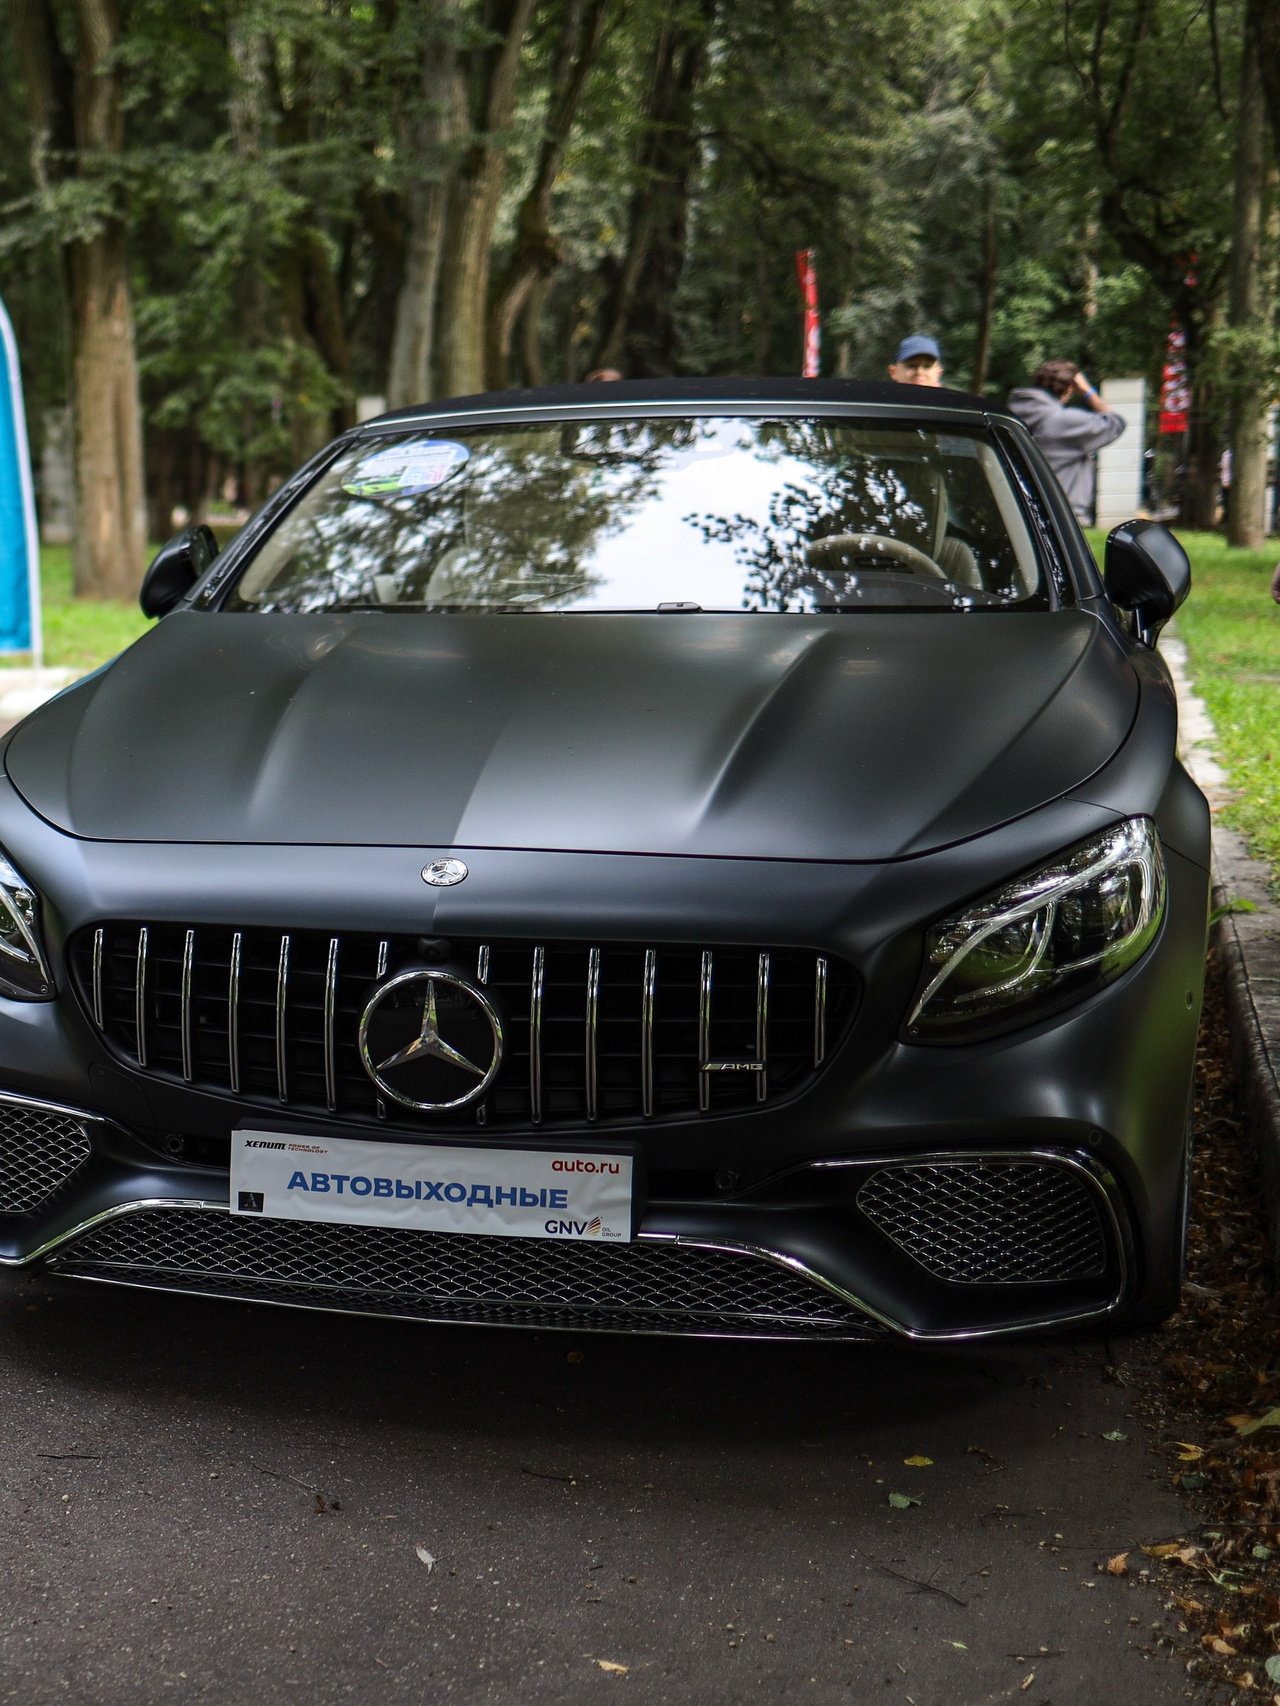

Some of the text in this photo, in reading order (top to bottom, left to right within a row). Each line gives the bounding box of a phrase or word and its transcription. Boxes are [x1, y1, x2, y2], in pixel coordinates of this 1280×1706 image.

[551, 1159, 620, 1174] auto.ru
[287, 1171, 568, 1209] АВТОВЫХОДНЫЕ
[544, 1220, 588, 1236] GNV
